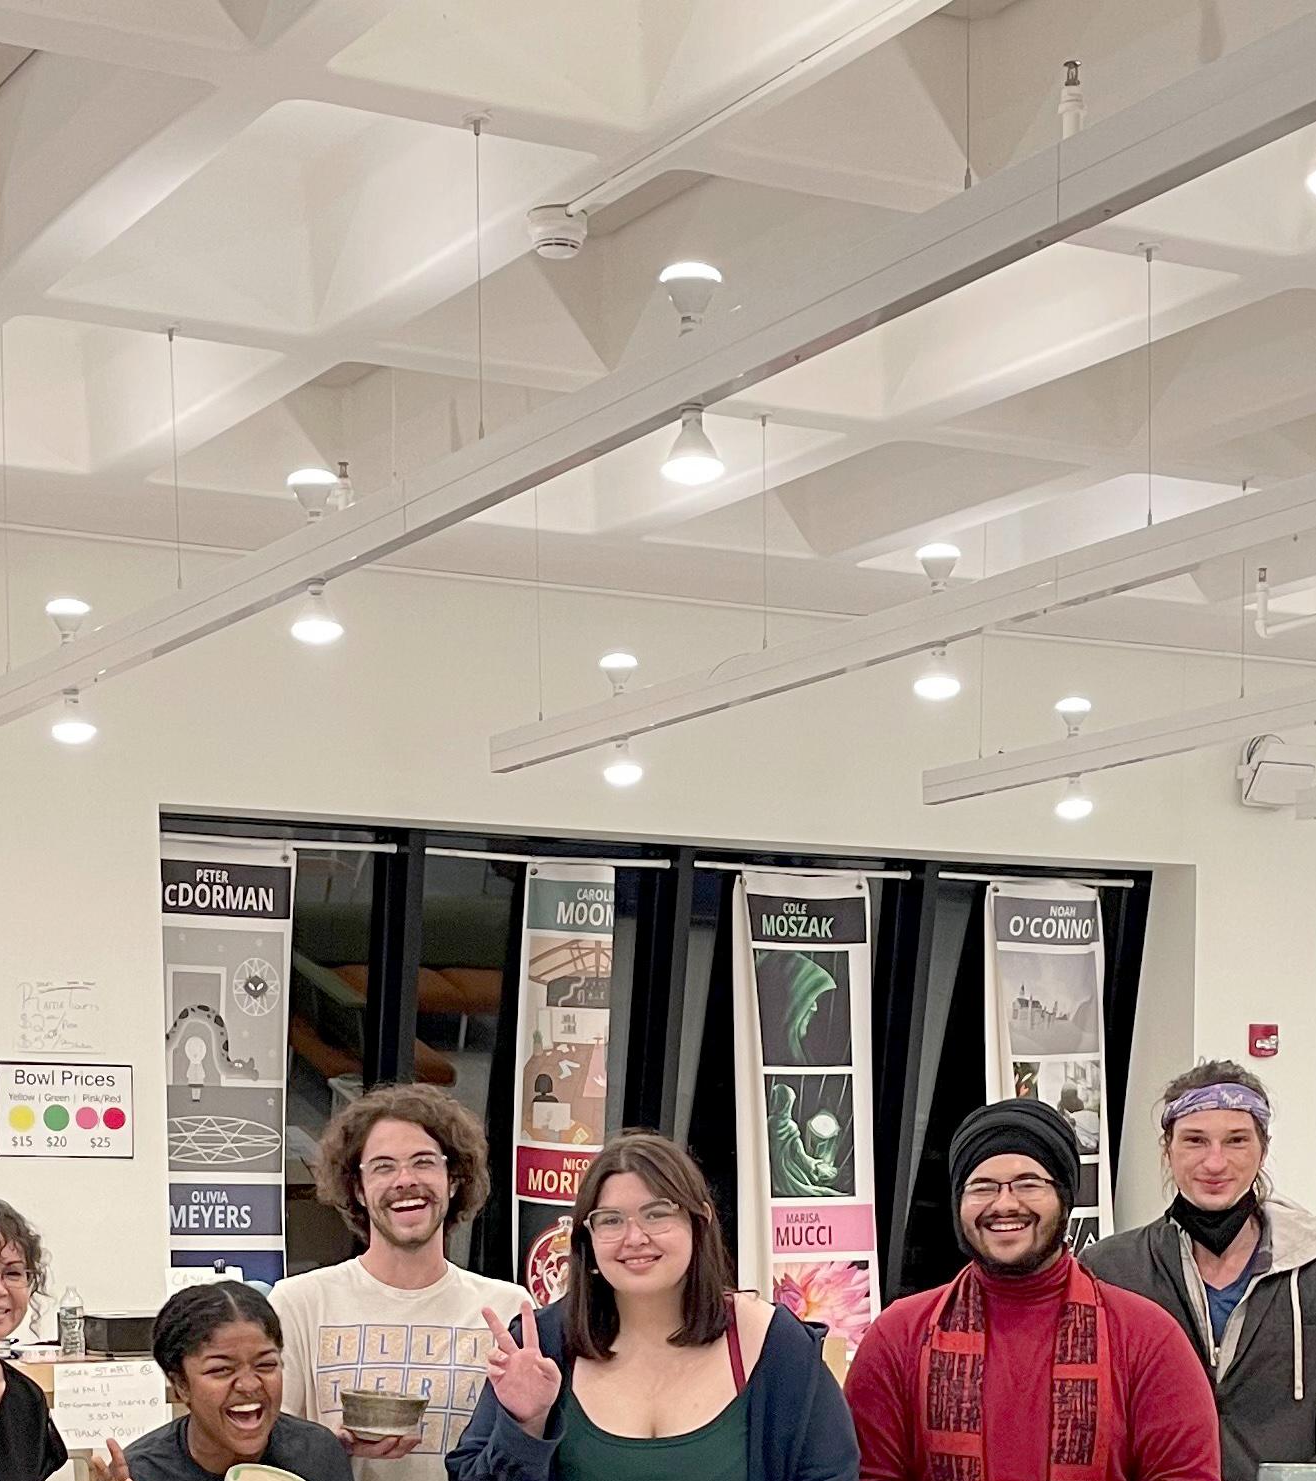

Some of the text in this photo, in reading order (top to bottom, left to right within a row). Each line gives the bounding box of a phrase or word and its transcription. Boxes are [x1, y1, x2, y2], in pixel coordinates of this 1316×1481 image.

[196, 869, 229, 883] PETER
[163, 882, 274, 912] CDORMAN
[783, 902, 808, 914] COLE
[1049, 906, 1076, 917] NOAH
[762, 914, 834, 938] MOSZAK
[1009, 915, 1094, 939] O'CONNO
[14, 1069, 115, 1087] Bowl Prices
[9, 1093, 35, 1101] Yellow
[44, 1093, 70, 1102] Green
[11, 1135, 111, 1148] $15 $20 $25
[563, 1158, 591, 1171] NICO
[528, 1168, 580, 1194] MORI
[191, 1190, 229, 1204] OLIVIA
[170, 1205, 252, 1229] MEYERS
[786, 1213, 821, 1224] MARISA
[776, 1225, 833, 1246] MUCCI
